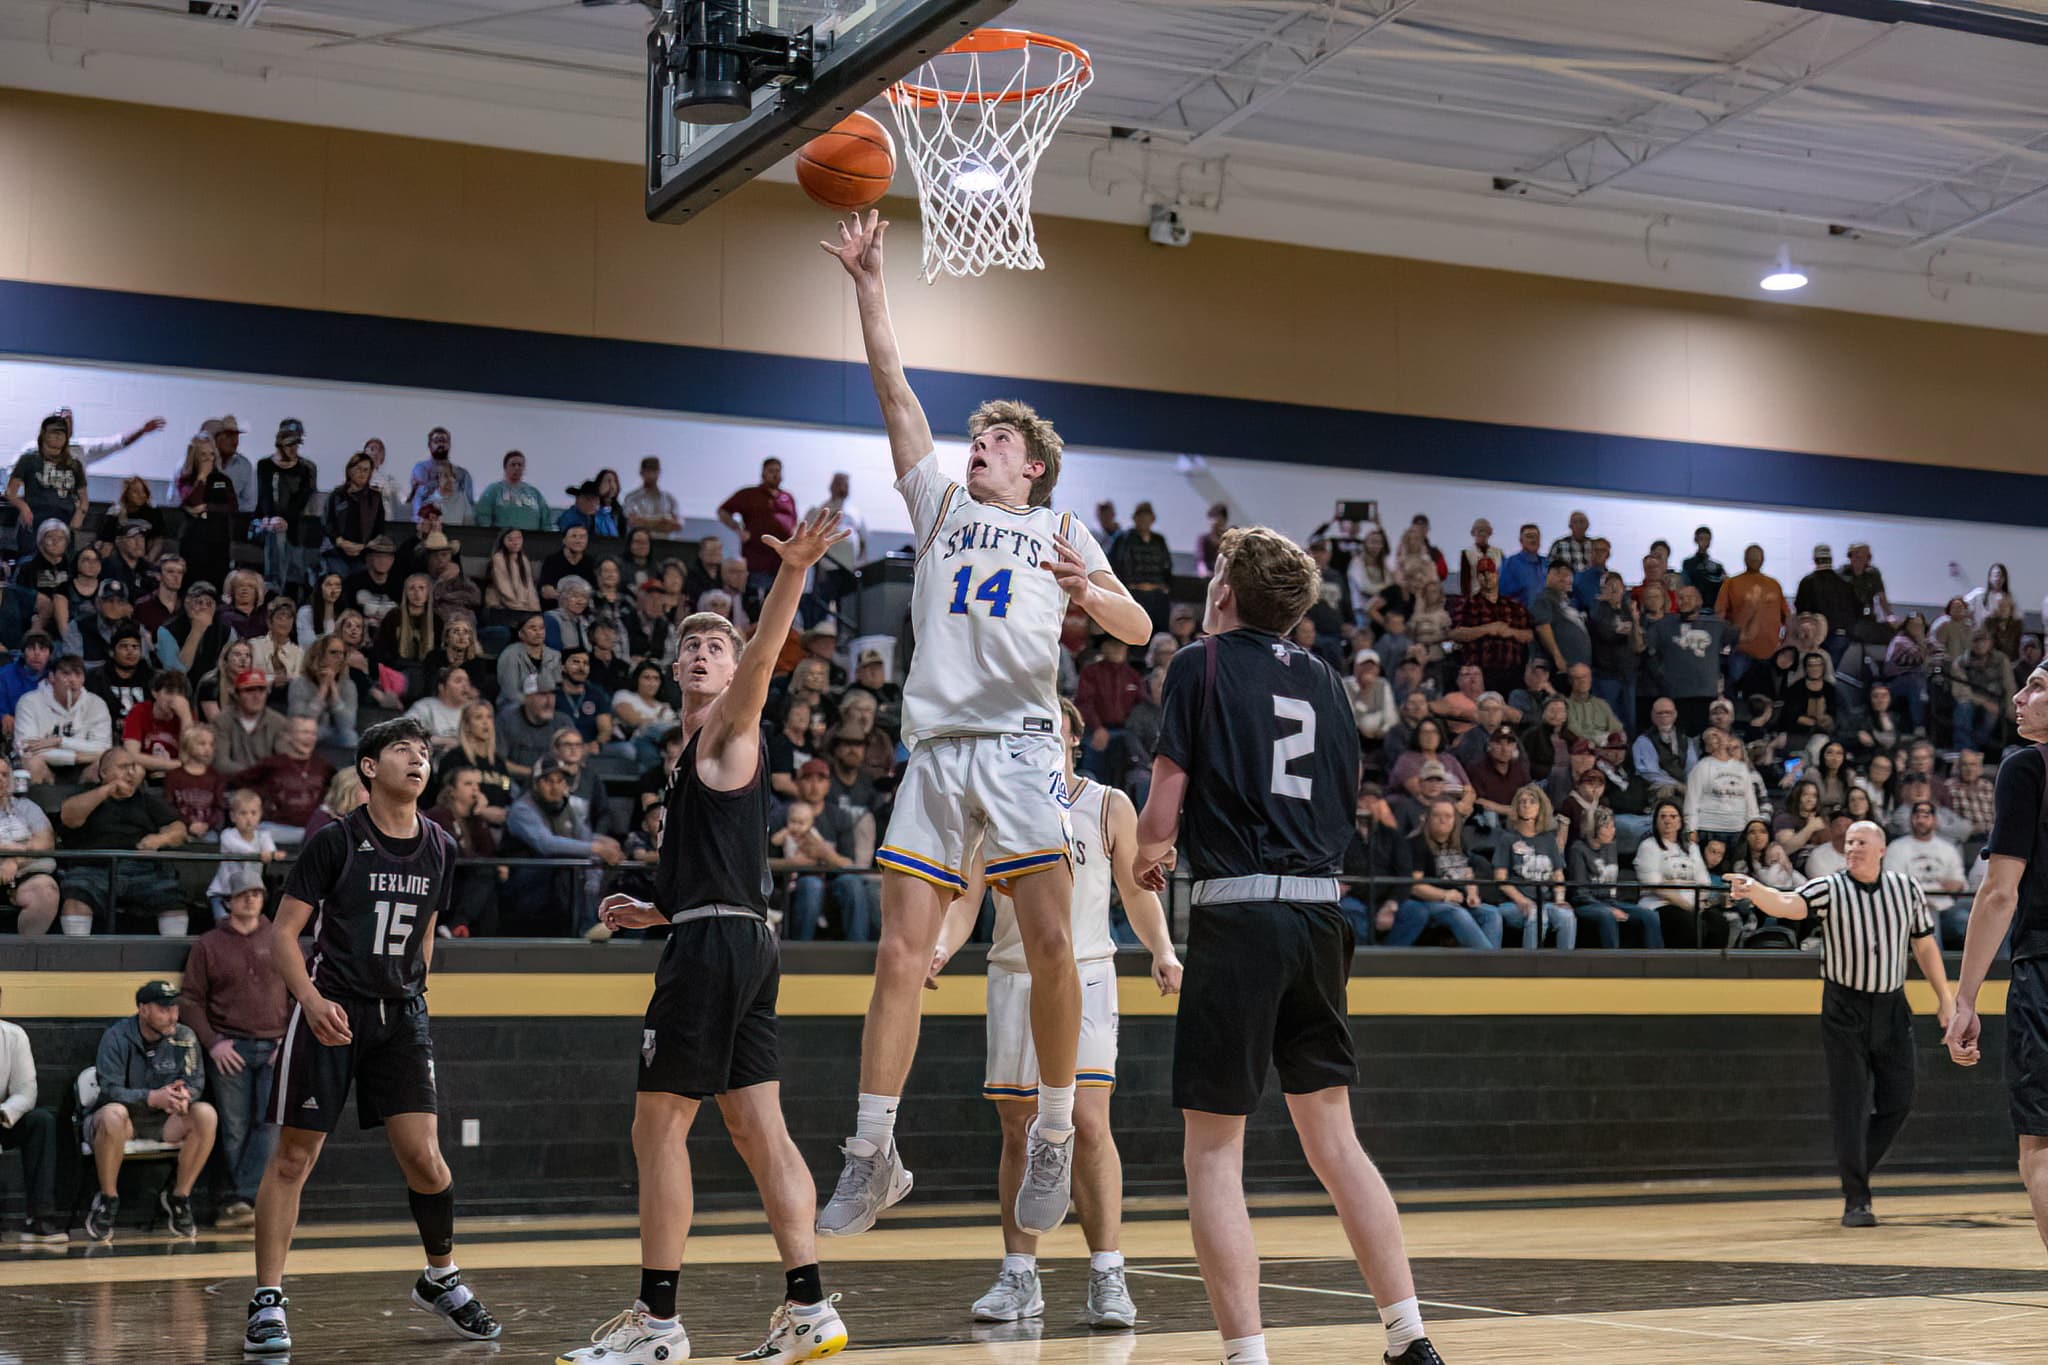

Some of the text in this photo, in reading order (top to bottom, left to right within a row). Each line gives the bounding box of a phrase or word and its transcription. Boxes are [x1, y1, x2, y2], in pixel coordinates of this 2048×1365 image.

[943, 522, 1042, 568] SWIFTS
[949, 564, 1014, 618] 14
[1271, 694, 1316, 801] 2
[369, 873, 431, 896] TEXLINE
[373, 901, 418, 956] 15
